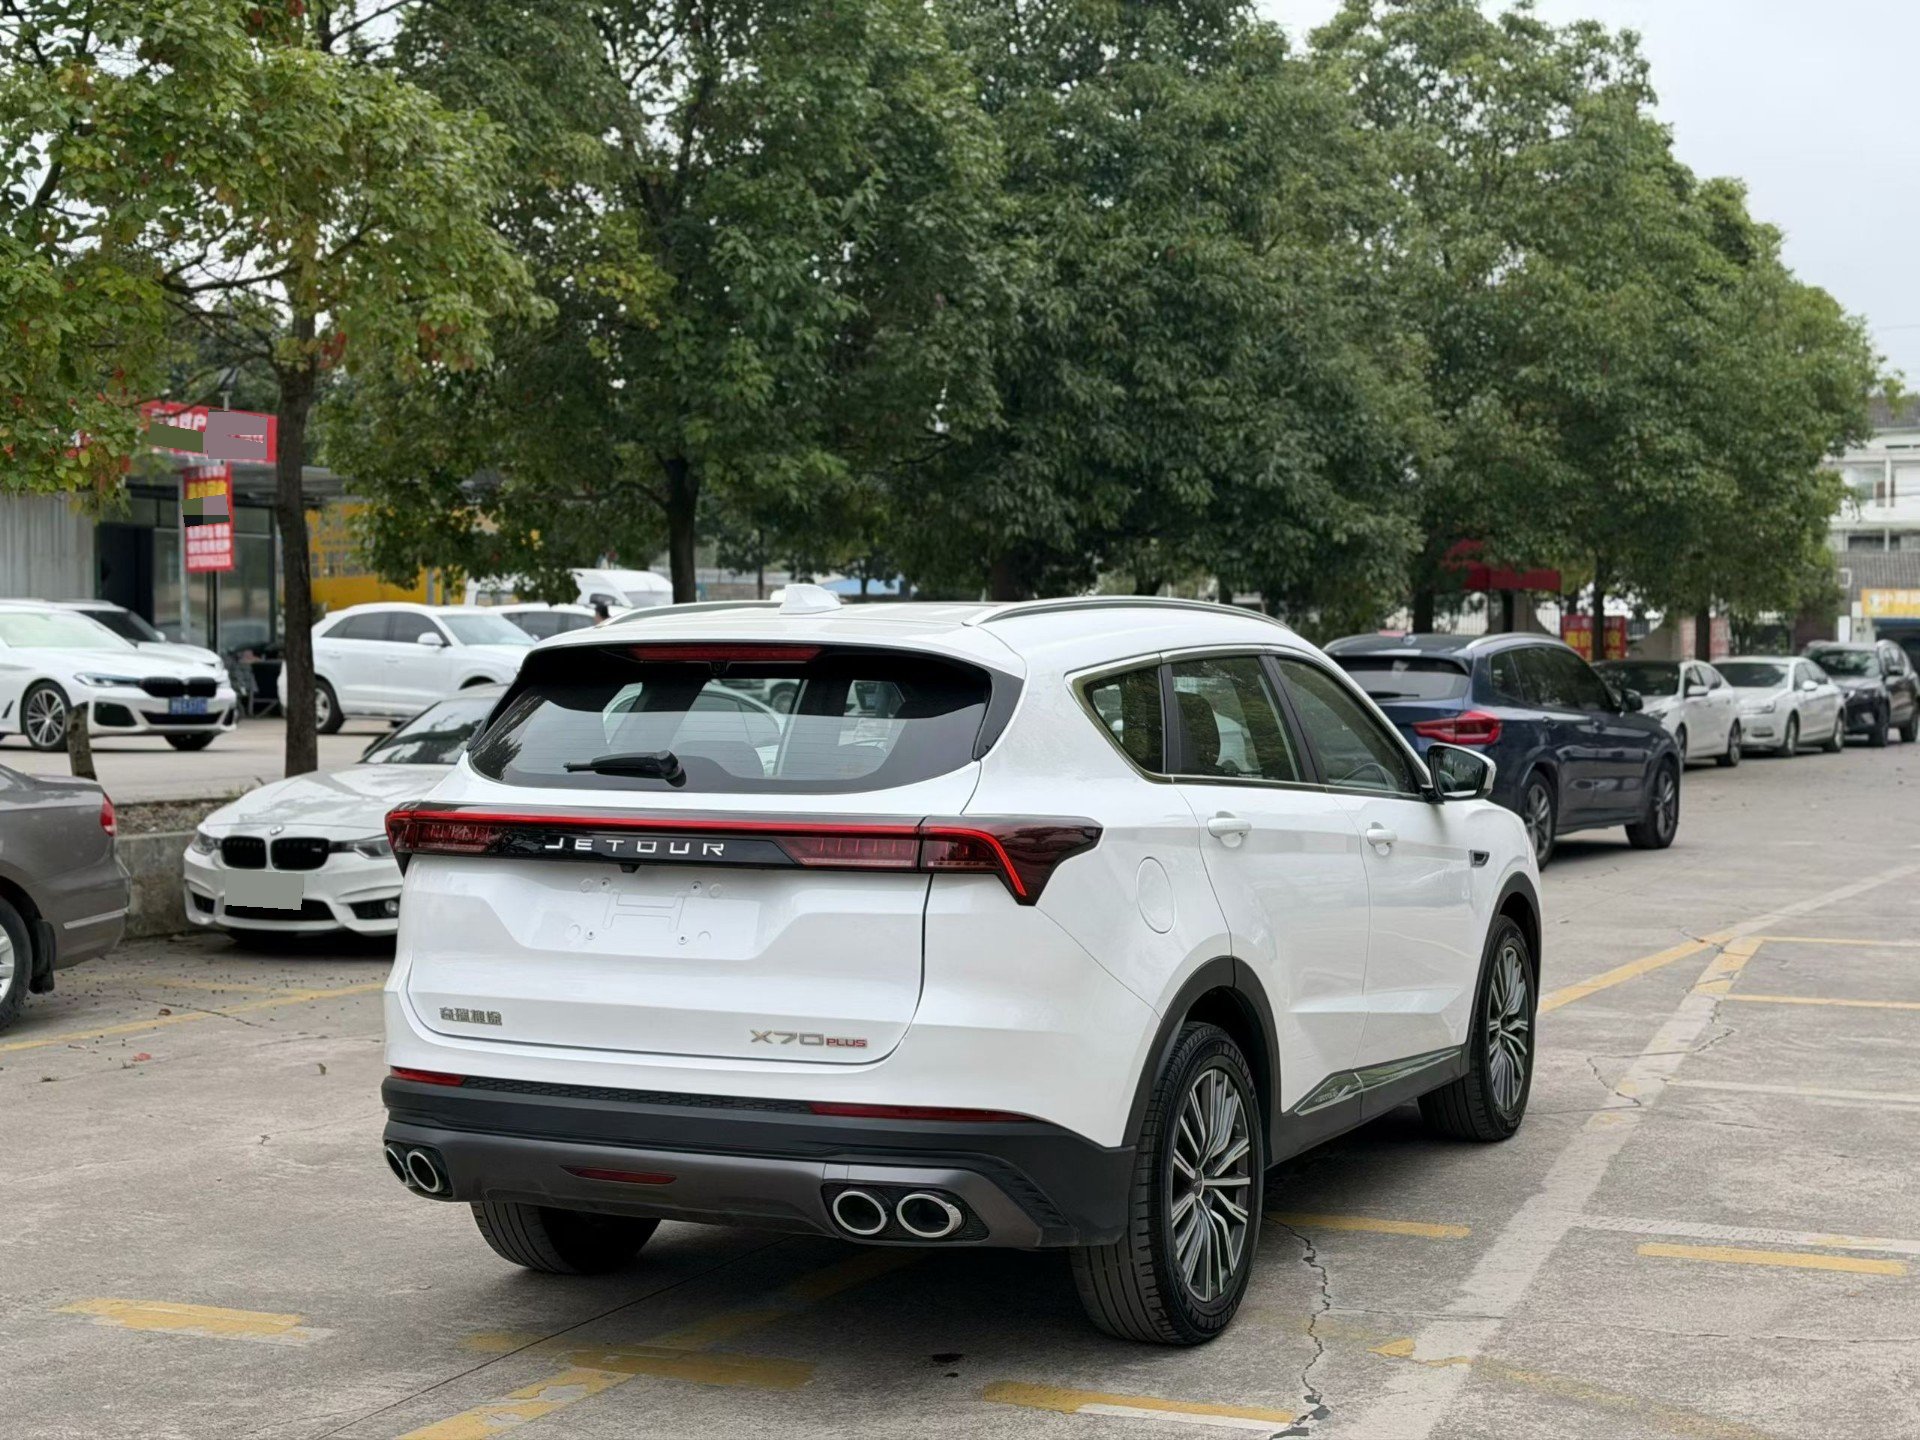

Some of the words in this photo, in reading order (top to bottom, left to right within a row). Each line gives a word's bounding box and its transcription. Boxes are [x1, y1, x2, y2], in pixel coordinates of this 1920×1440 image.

[544, 837, 725, 856] JETOUR
[750, 1029, 824, 1046] X70
[826, 1037, 867, 1048] PLUS
